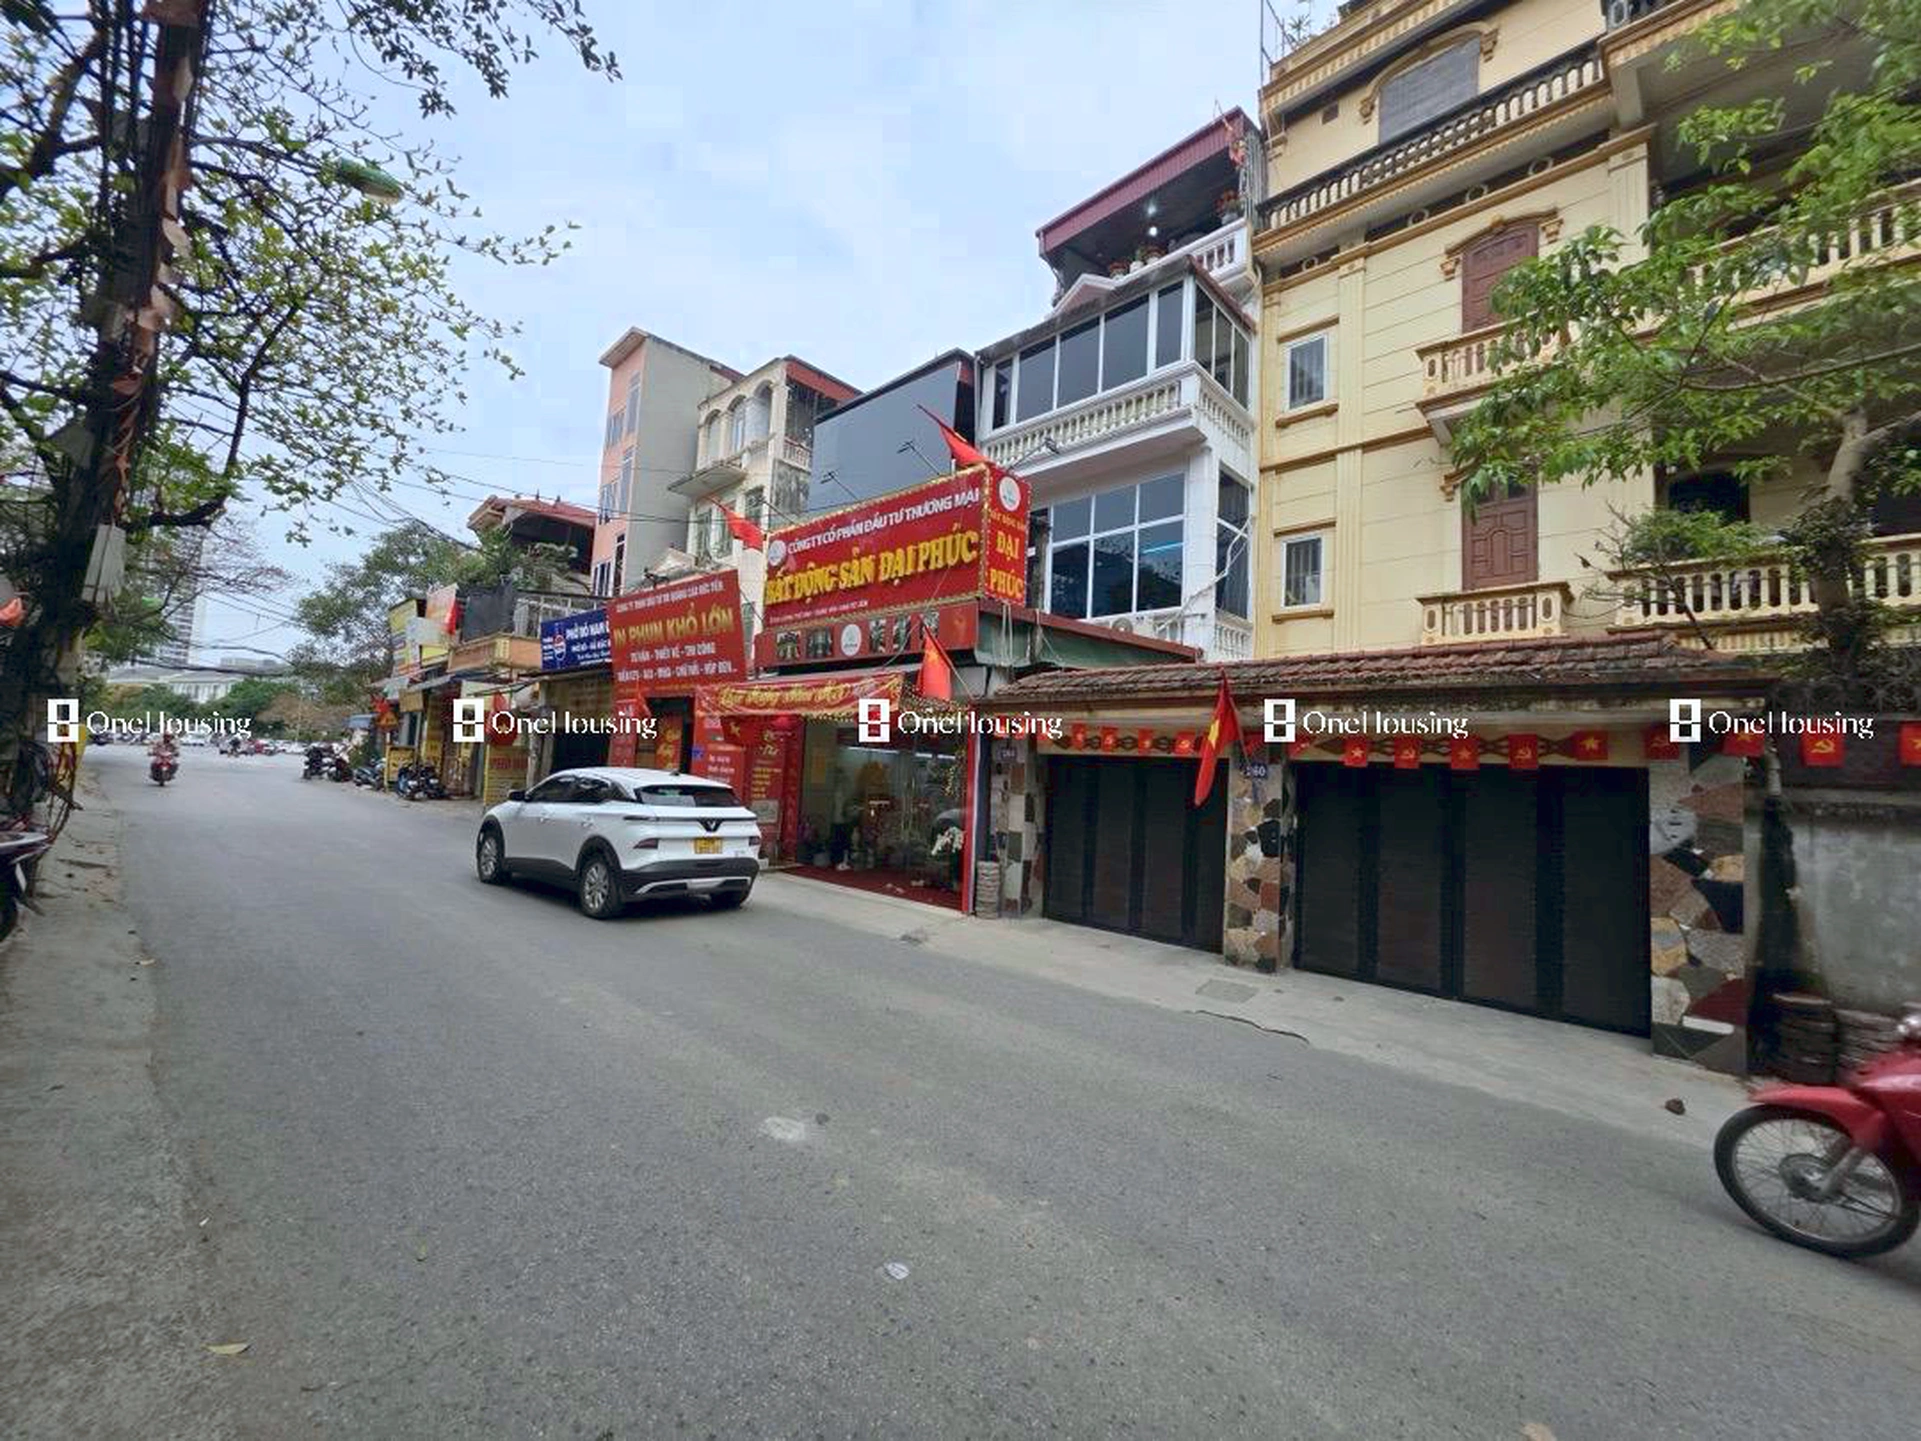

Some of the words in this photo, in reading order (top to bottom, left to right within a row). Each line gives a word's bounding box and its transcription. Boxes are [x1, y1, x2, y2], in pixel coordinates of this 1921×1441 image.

[954, 487, 979, 509] MẠI
[838, 546, 875, 590] SẢN
[880, 545, 916, 587] ĐẠI
[917, 522, 979, 572] PHÚC
[996, 530, 1020, 561] ĐẠI
[989, 568, 1024, 599] PHÚC
[629, 621, 664, 645] PHUN
[666, 602, 698, 641] KHỔ
[701, 603, 735, 635] LỚN
